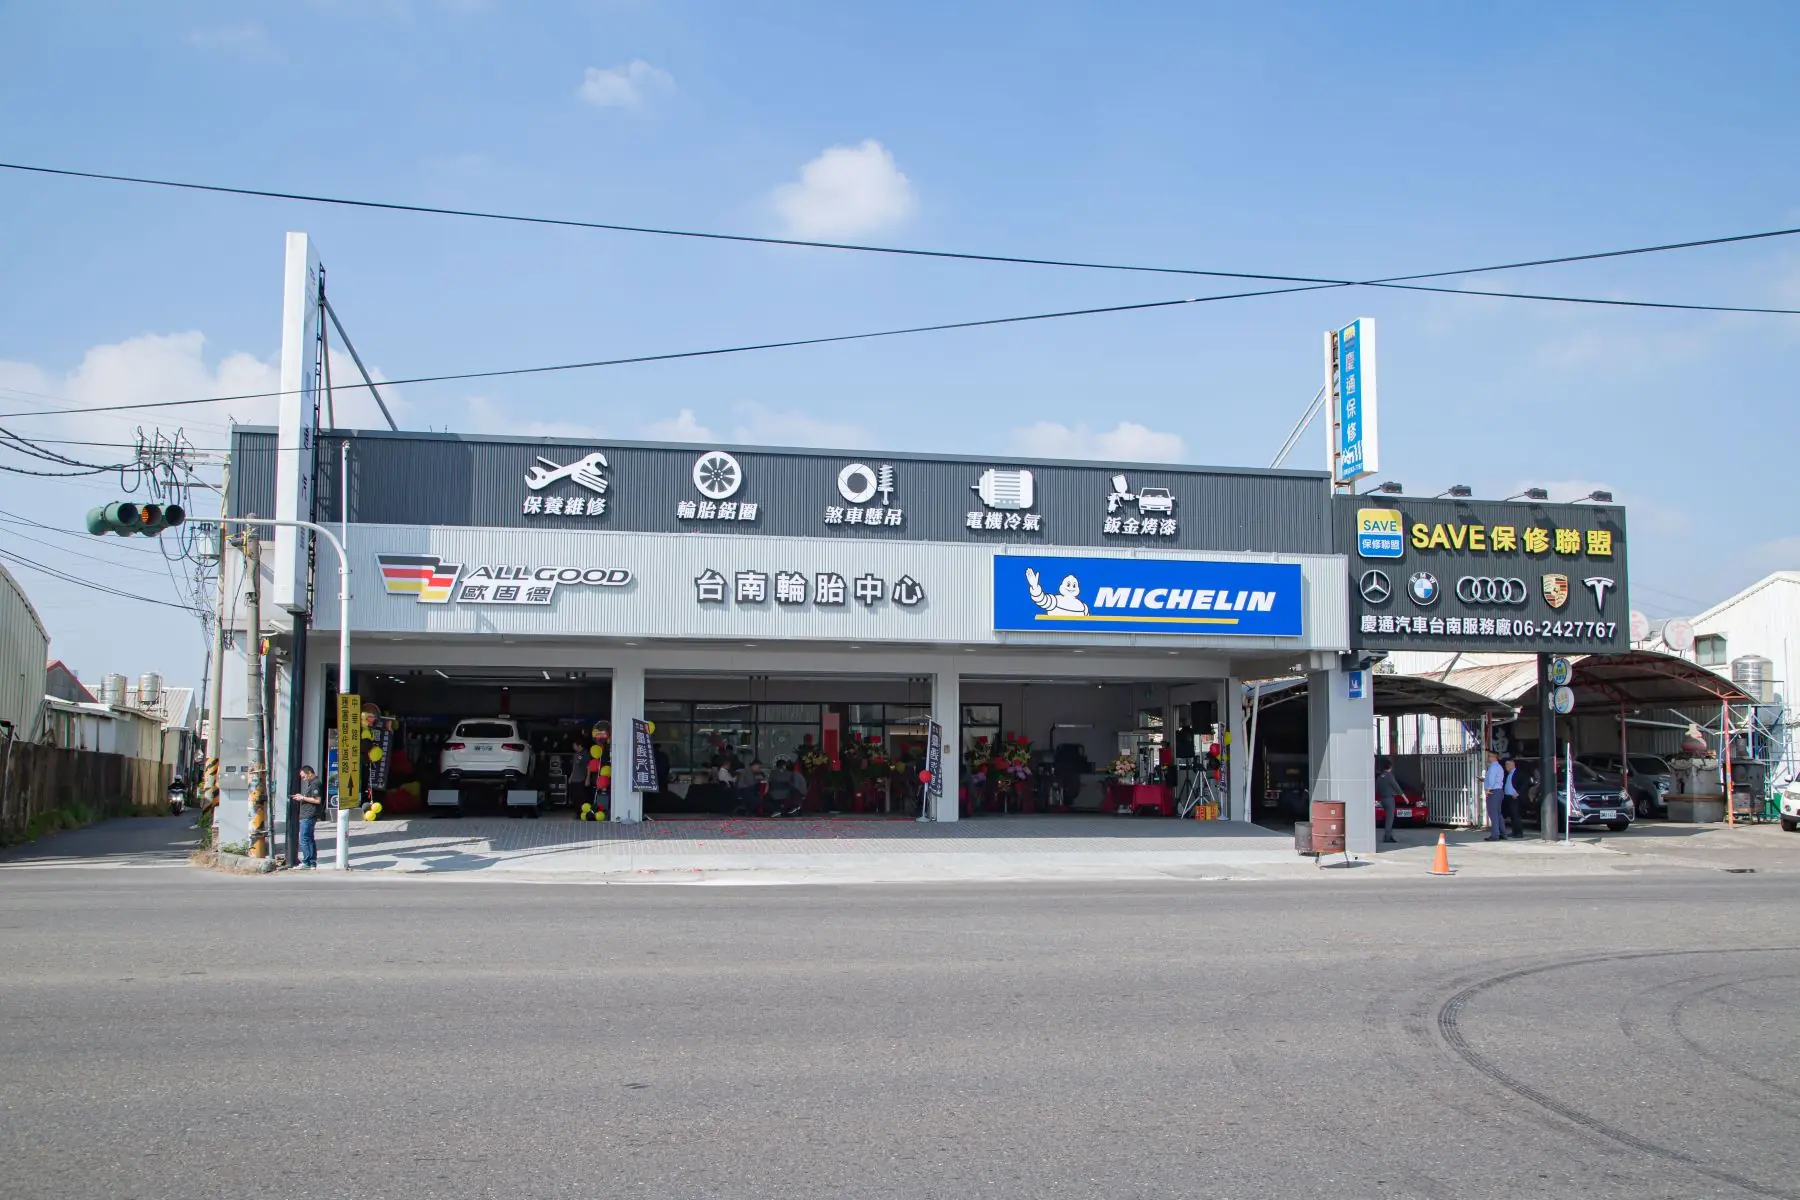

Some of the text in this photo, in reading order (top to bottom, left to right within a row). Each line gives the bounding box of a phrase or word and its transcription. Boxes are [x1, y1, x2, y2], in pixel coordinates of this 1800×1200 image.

[523, 496, 606, 516] 保養維修
[676, 501, 757, 521] 輪胎鋁圈
[824, 505, 904, 525] 煞車懸吊
[966, 511, 1041, 532] 電機冷氣
[1103, 516, 1177, 536] 鈑金烤漆
[1363, 520, 1397, 531] SAVE
[1362, 538, 1400, 550] 保修聯盟
[459, 585, 551, 602] 歐固德
[697, 570, 925, 606] 台南輪胎中心
[1094, 587, 1276, 612] MICHELIN
